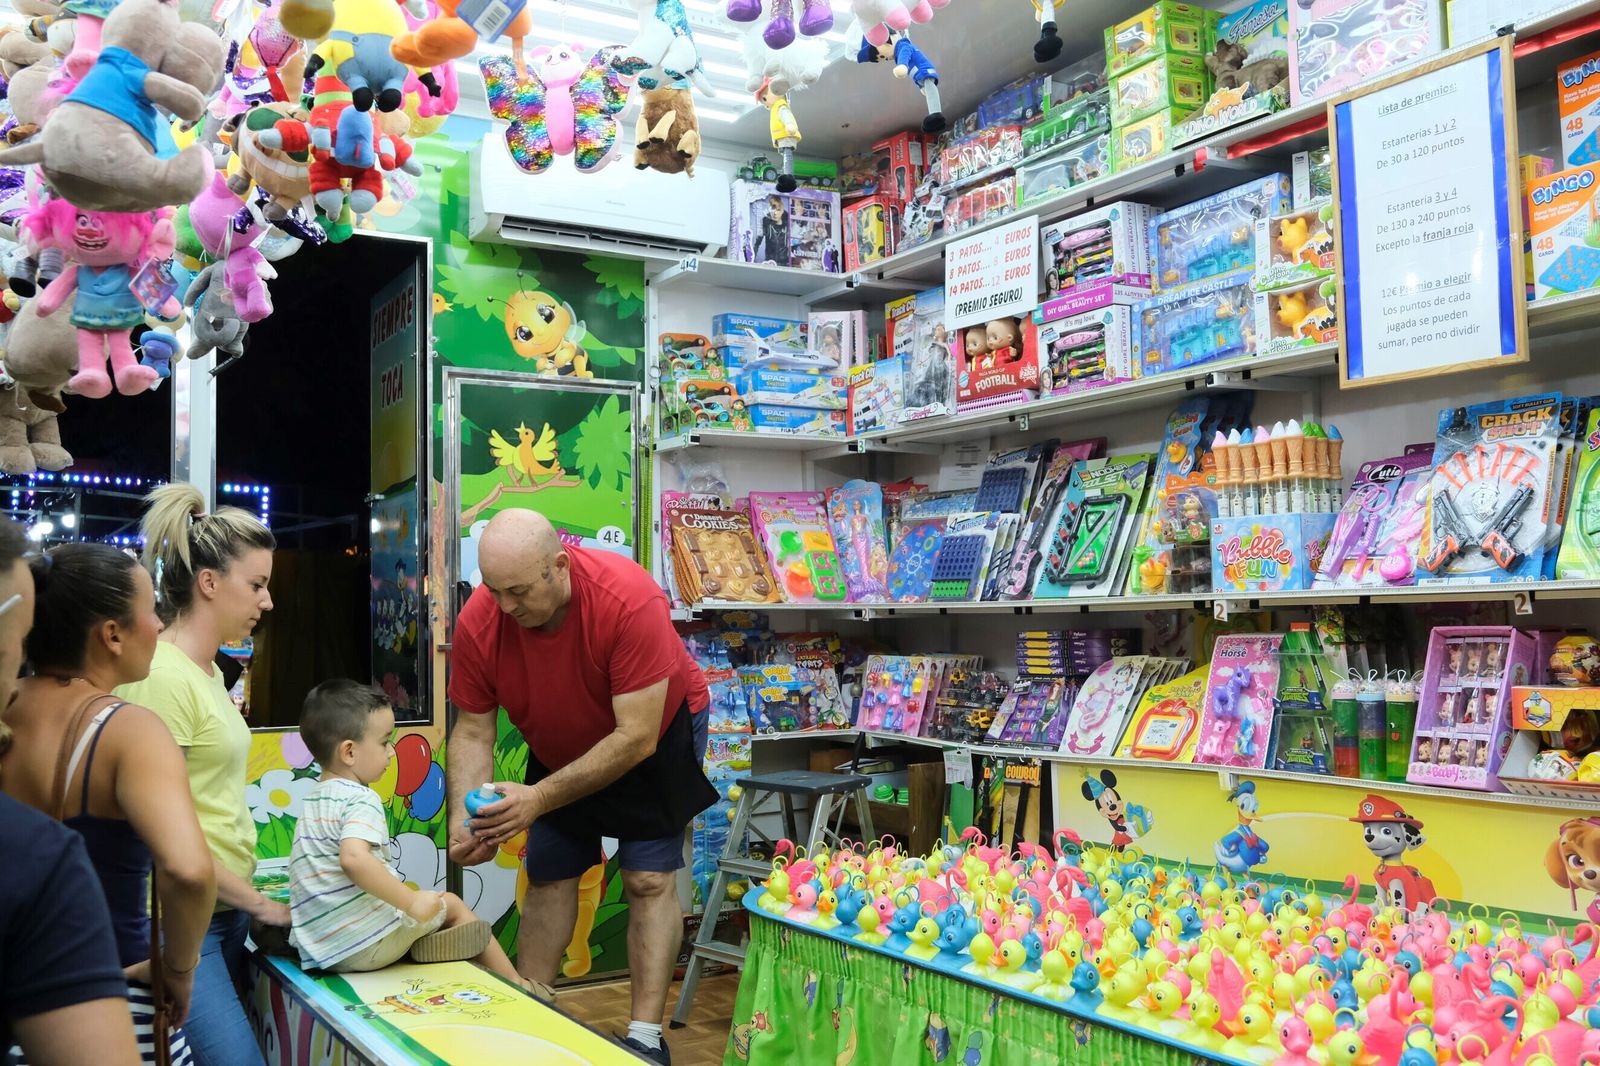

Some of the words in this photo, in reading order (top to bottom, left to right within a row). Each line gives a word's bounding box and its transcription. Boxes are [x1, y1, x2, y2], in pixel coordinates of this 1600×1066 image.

[1378, 103, 1398, 116] Lista
[1401, 97, 1412, 108] de
[1188, 116, 1215, 135] DINO
[1219, 100, 1257, 123] WORLD
[1450, 118, 1456, 128] 2
[1566, 117, 1584, 132] 48
[1376, 160, 1388, 170] De
[1391, 154, 1402, 166] 30
[1404, 153, 1409, 161] a
[1413, 145, 1429, 158] 120
[1431, 136, 1465, 154] puntos
[1435, 191, 1440, 201] 3
[1451, 187, 1457, 197] 4
[1532, 171, 1594, 206] BINGO
[1377, 225, 1388, 235] De
[1391, 219, 1408, 231] 130
[1409, 219, 1415, 227] a
[1418, 212, 1435, 225] 240
[1437, 205, 1471, 221] puntos
[950, 251, 955, 262] 3
[1005, 227, 1032, 244] EUROS
[1376, 238, 1410, 253] Excepto
[1413, 235, 1420, 243] la
[1423, 227, 1451, 242] franja
[1454, 222, 1474, 235] roja
[1537, 236, 1554, 250] 48
[1005, 245, 1031, 263] EUROS
[689, 258, 697, 270] 4
[1005, 264, 1031, 281] EUROS
[1158, 292, 1187, 306] DREAM
[1187, 287, 1201, 298] ICE
[1202, 278, 1234, 293] CASTLE
[1382, 286, 1397, 298] 12€
[1443, 272, 1472, 286] elegir
[955, 297, 988, 316] (PREMIO
[989, 287, 1023, 307] SEGURO)
[1047, 308, 1057, 316] DIY
[1058, 304, 1071, 312] GIRL
[1072, 298, 1093, 309] BEAUTY
[1095, 294, 1106, 303] SET
[1383, 306, 1398, 316] Los
[1400, 300, 1431, 315] puntos
[1434, 296, 1445, 306] de
[1448, 291, 1471, 303] cada
[373, 285, 413, 349] SIEMPRE
[730, 318, 759, 327] SPACE
[1386, 319, 1417, 334] jugada
[1419, 317, 1429, 326] se
[1432, 310, 1468, 325] pueden
[1378, 338, 1409, 350] sumar,
[1411, 333, 1433, 346] pero
[1435, 331, 1448, 340] no
[1450, 323, 1481, 337] dividir
[381, 363, 403, 409] TOCA
[761, 374, 790, 382] SPACE
[975, 374, 1016, 392] FOOTBALL
[761, 409, 790, 417] SPACE
[1020, 416, 1027, 429] 3
[1481, 407, 1553, 429] CRACK
[1487, 422, 1541, 440] SHOT
[1369, 465, 1401, 481] Cutie
[1217, 535, 1292, 567] Bubble
[1235, 559, 1277, 578] FUN
[1215, 603, 1225, 620] 2
[1515, 593, 1528, 613] 2
[862, 609, 868, 620] 2
[1220, 649, 1247, 659] Horse
